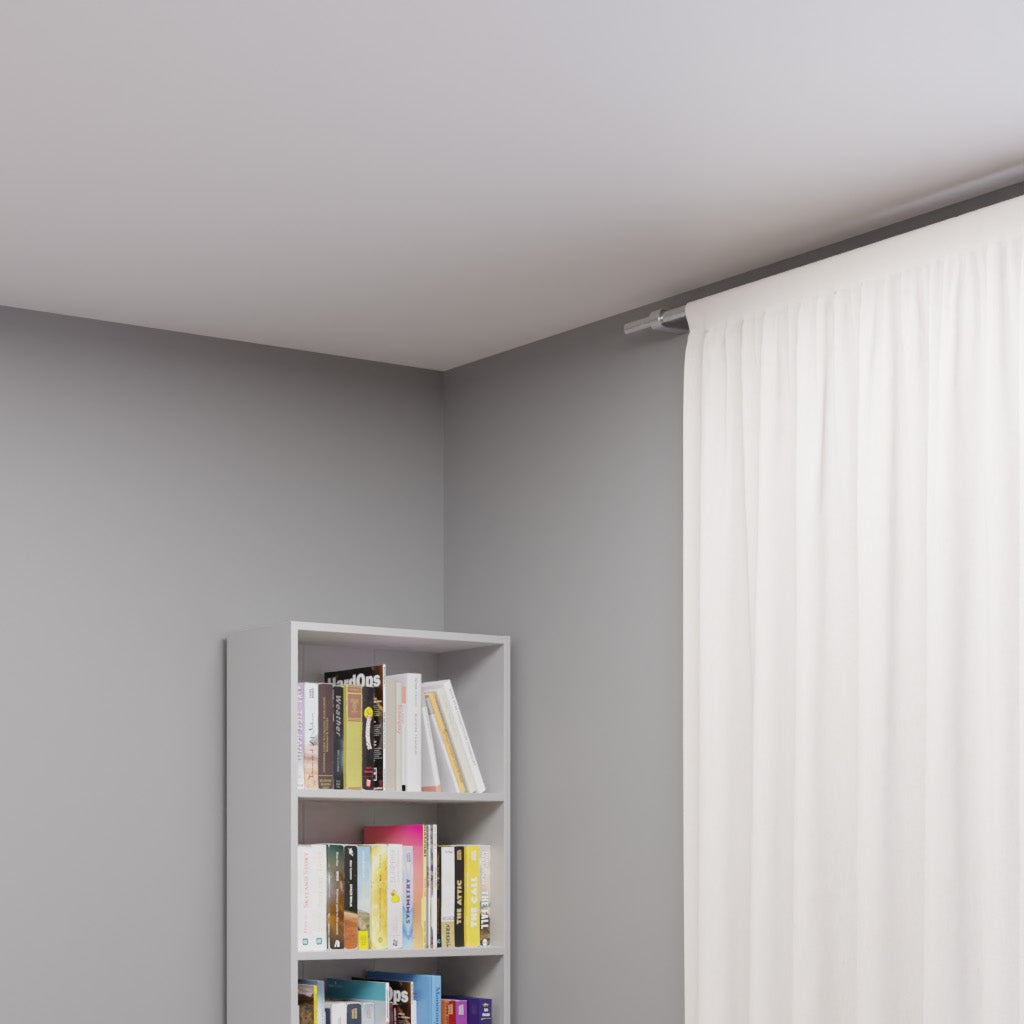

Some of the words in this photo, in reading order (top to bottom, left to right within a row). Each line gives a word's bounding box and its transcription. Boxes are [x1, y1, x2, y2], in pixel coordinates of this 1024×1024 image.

[471, 877, 479, 904] CALL
[481, 891, 489, 907] THE
[470, 907, 478, 928] THE
[481, 909, 489, 930] FALL
